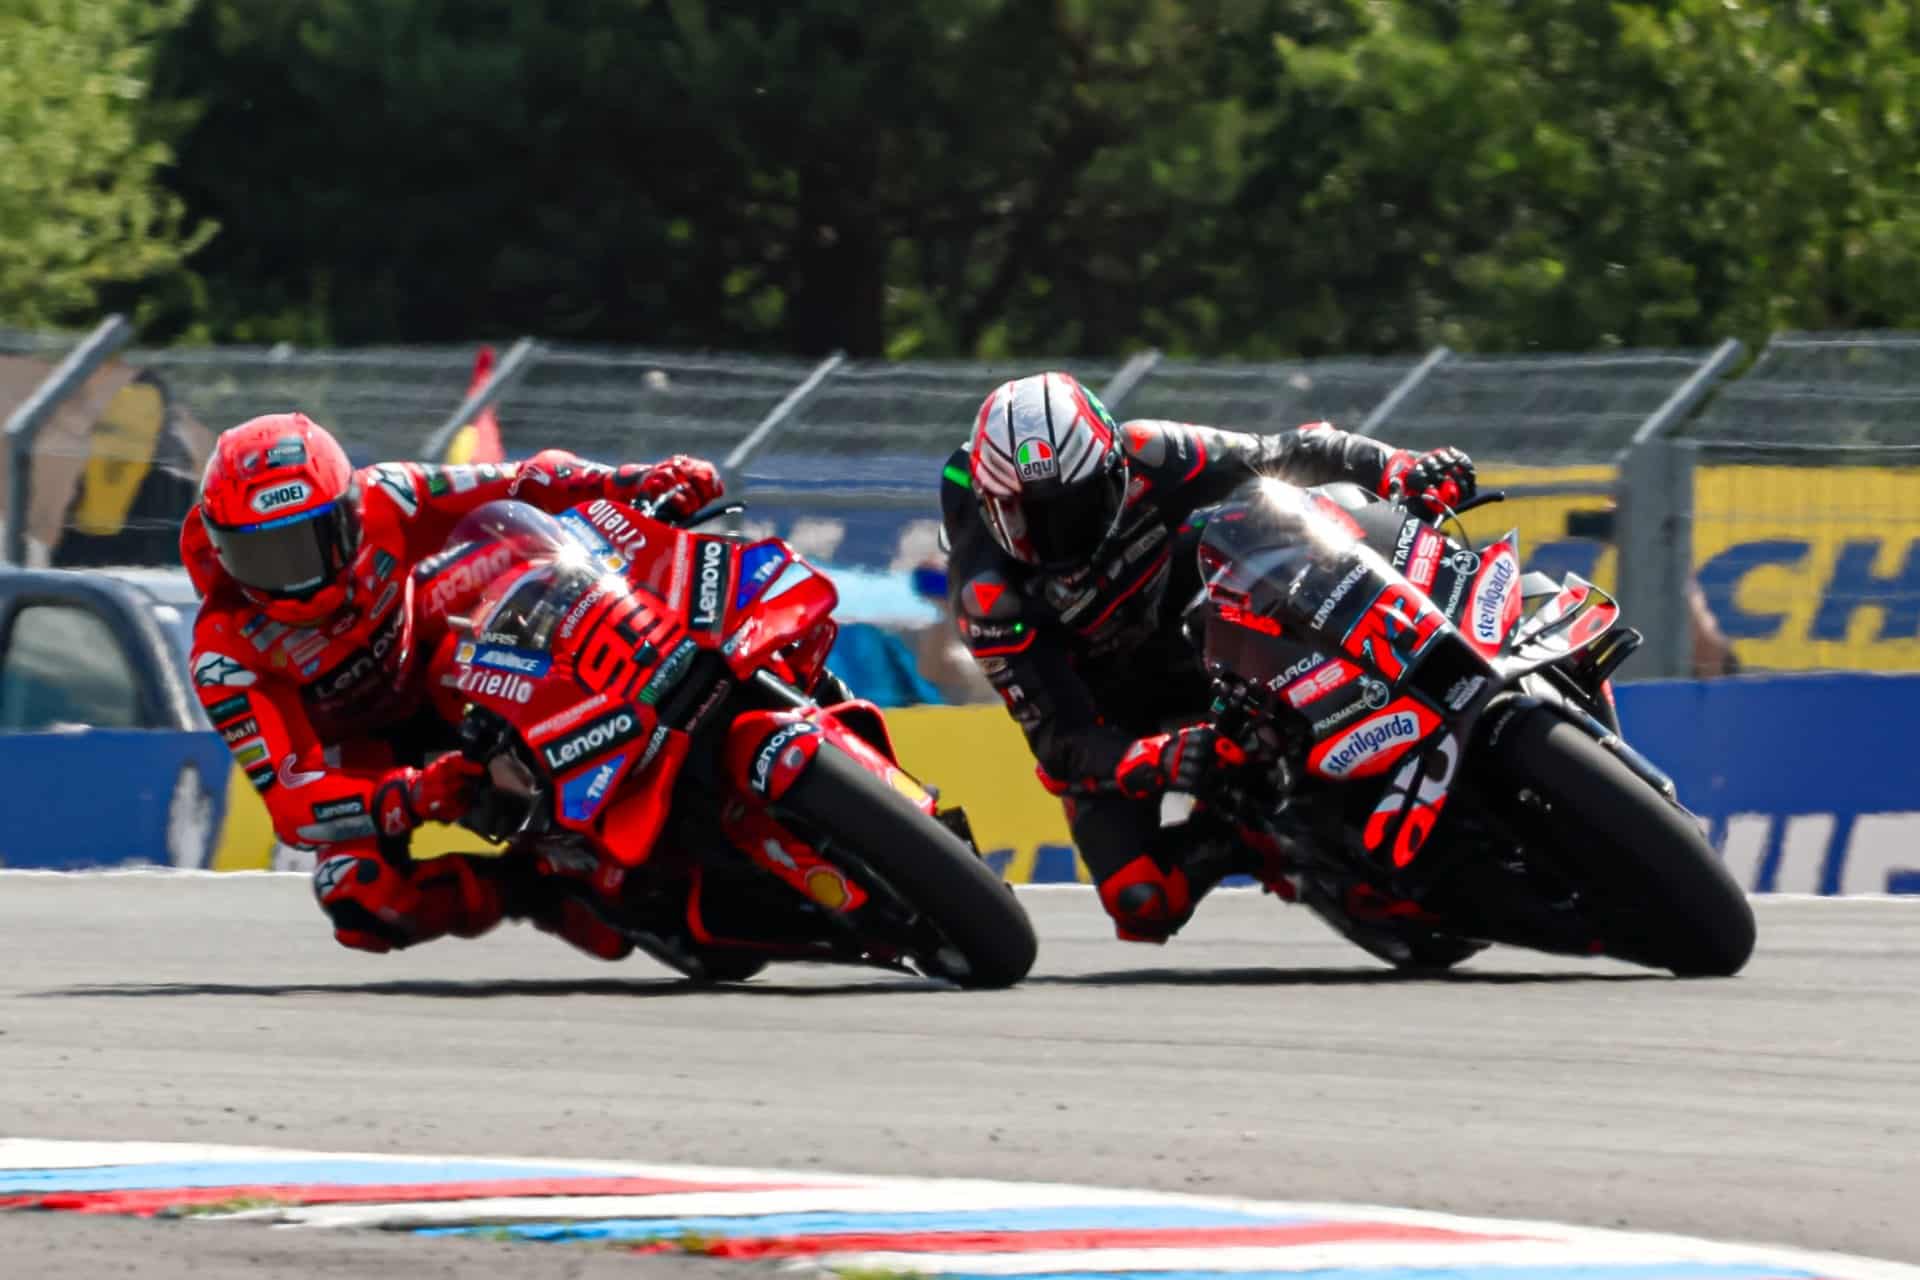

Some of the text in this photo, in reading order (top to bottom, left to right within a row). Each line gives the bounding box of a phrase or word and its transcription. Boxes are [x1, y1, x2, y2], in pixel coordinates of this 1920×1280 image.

[1022, 461, 1051, 477] agv
[260, 485, 304, 509] SHOEI
[753, 554, 784, 582] TIM
[1392, 518, 1420, 567] TARGA
[1408, 530, 1438, 585] BS
[694, 541, 722, 624] Lenovo
[1310, 563, 1368, 631] LINO SONEG
[1479, 557, 1516, 638] sterilgarda
[576, 587, 688, 700] 93
[1266, 651, 1325, 691] TARGA
[1287, 662, 1345, 708] BS
[545, 714, 633, 769] Lenovo
[751, 721, 813, 792] Lenovo
[1327, 715, 1414, 774] sterilgarda
[586, 765, 614, 798] TIM
